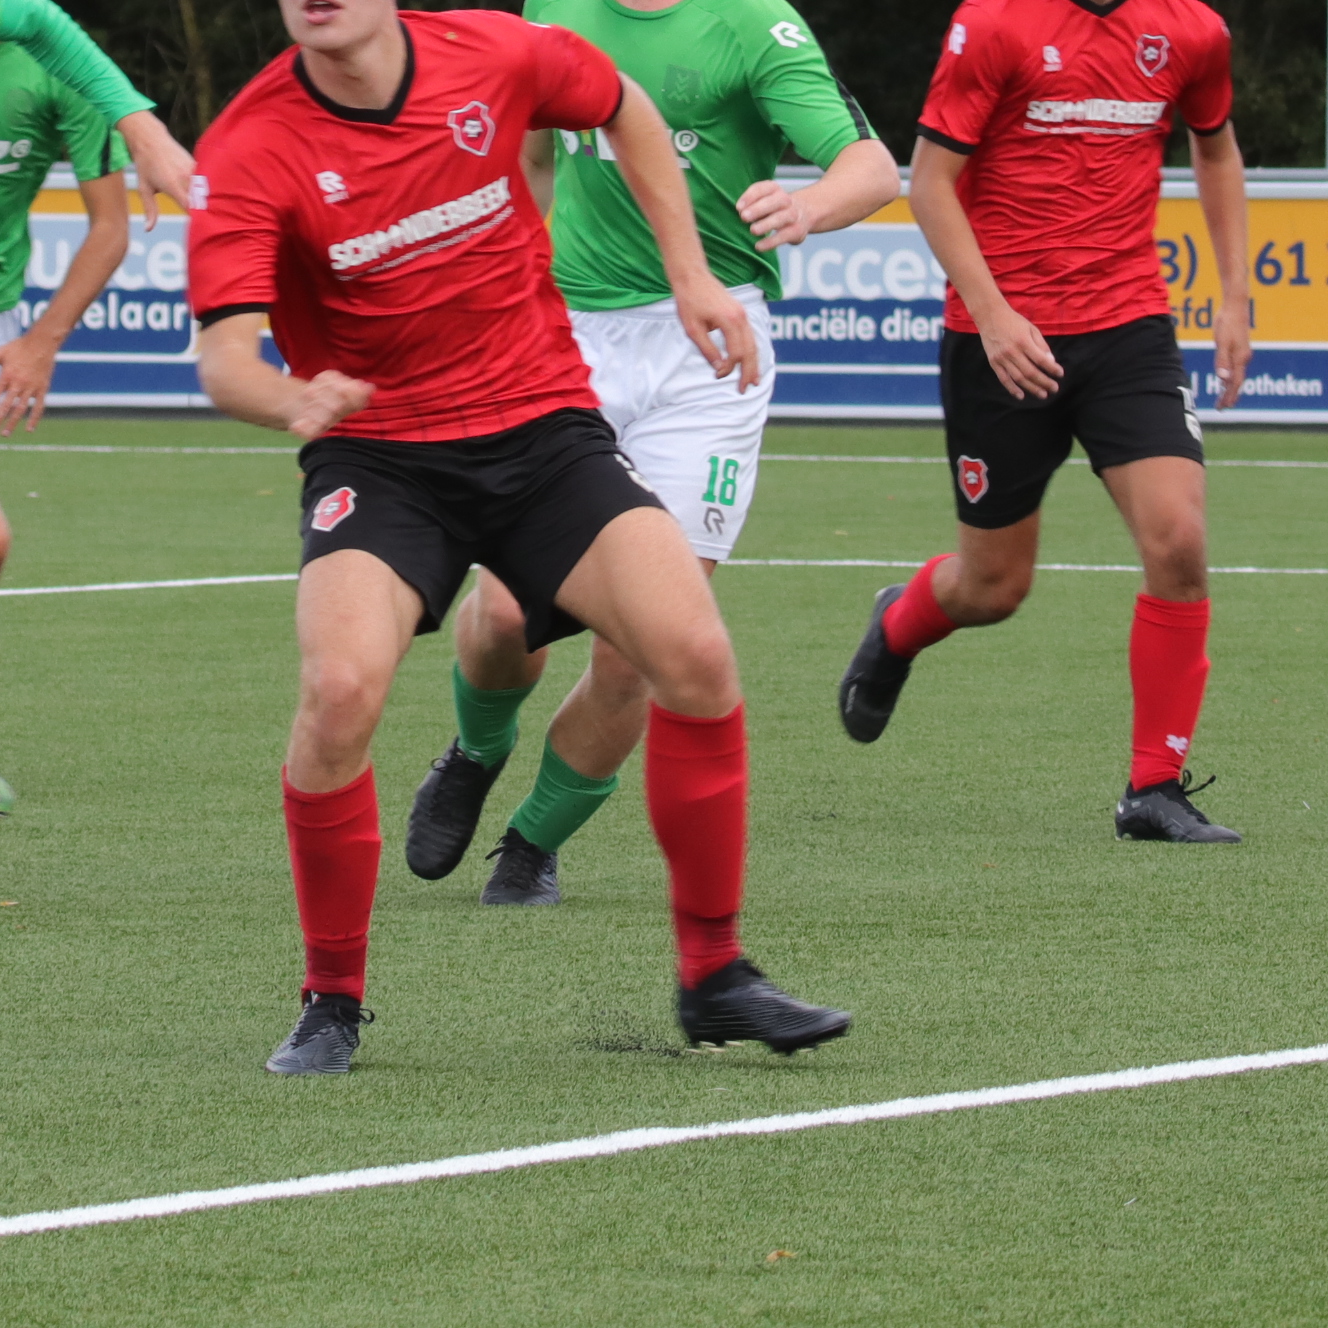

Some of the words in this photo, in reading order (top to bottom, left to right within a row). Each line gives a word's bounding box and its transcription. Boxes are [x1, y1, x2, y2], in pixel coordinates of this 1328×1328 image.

[1254, 241, 1311, 286] 61
[770, 307, 876, 341] anciële
[1206, 372, 1323, 396] Hotheken
[701, 455, 739, 506] 18
